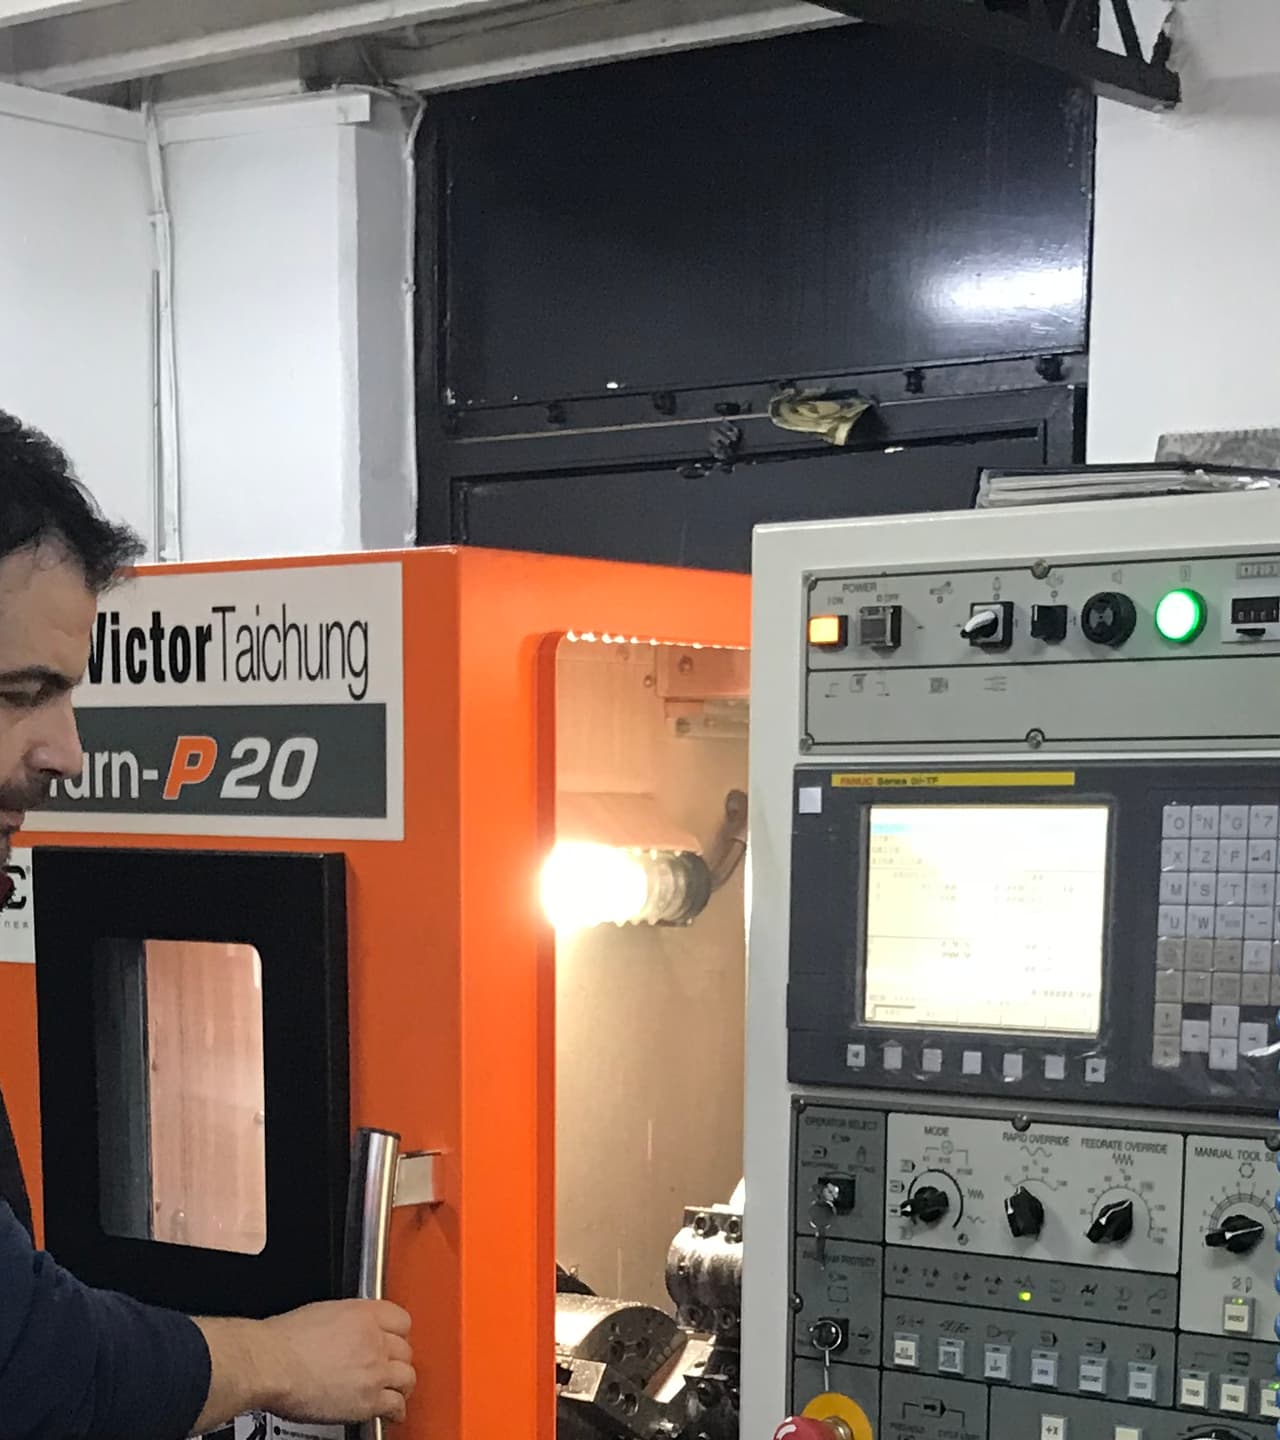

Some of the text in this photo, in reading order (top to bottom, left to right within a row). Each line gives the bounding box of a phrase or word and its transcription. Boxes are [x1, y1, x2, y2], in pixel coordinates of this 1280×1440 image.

[842, 582, 877, 594] POWER
[1203, 818, 1213, 829] N
[1232, 818, 1242, 829] G
[1263, 816, 1273, 828] 7
[1173, 851, 1183, 862] X
[1230, 851, 1240, 863] F
[1171, 885, 1182, 896] M
[1199, 885, 1210, 897] S
[1229, 885, 1239, 897] T
[1170, 918, 1180, 929] U
[1198, 918, 1209, 929] W
[923, 1126, 950, 1136] MODE
[1002, 1131, 1070, 1147] RAPID OVERRIDE
[1081, 1137, 1168, 1155] FEEDRATE OVERRIDE
[1194, 1146, 1233, 1159] MANUAL
[1237, 1149, 1262, 1161] TOOL
